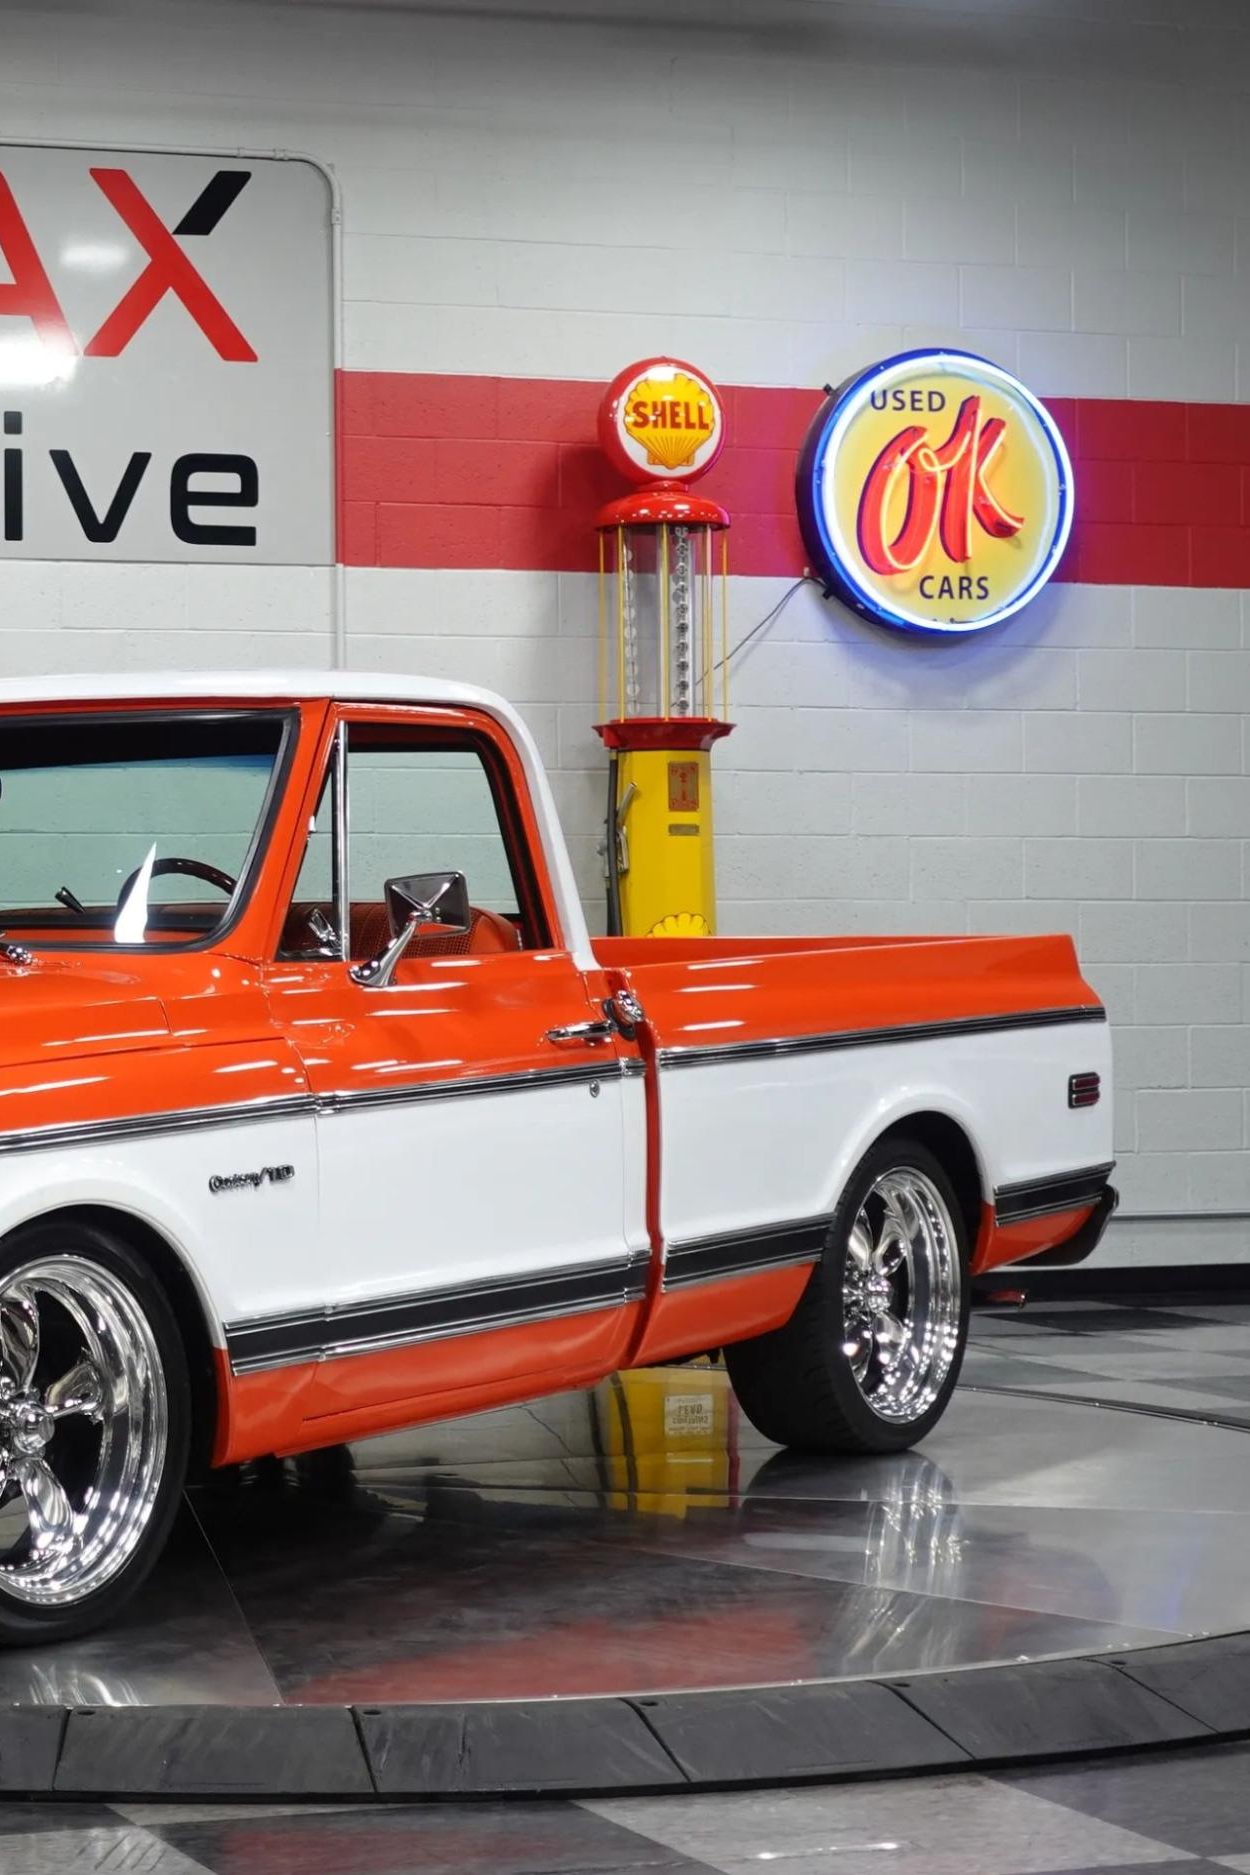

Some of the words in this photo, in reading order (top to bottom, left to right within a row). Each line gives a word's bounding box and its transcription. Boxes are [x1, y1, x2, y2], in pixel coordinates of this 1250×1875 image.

[871, 390, 946, 412] USED
[632, 400, 710, 430] SHELL
[857, 395, 1025, 576] OK
[919, 575, 989, 600] CARS
